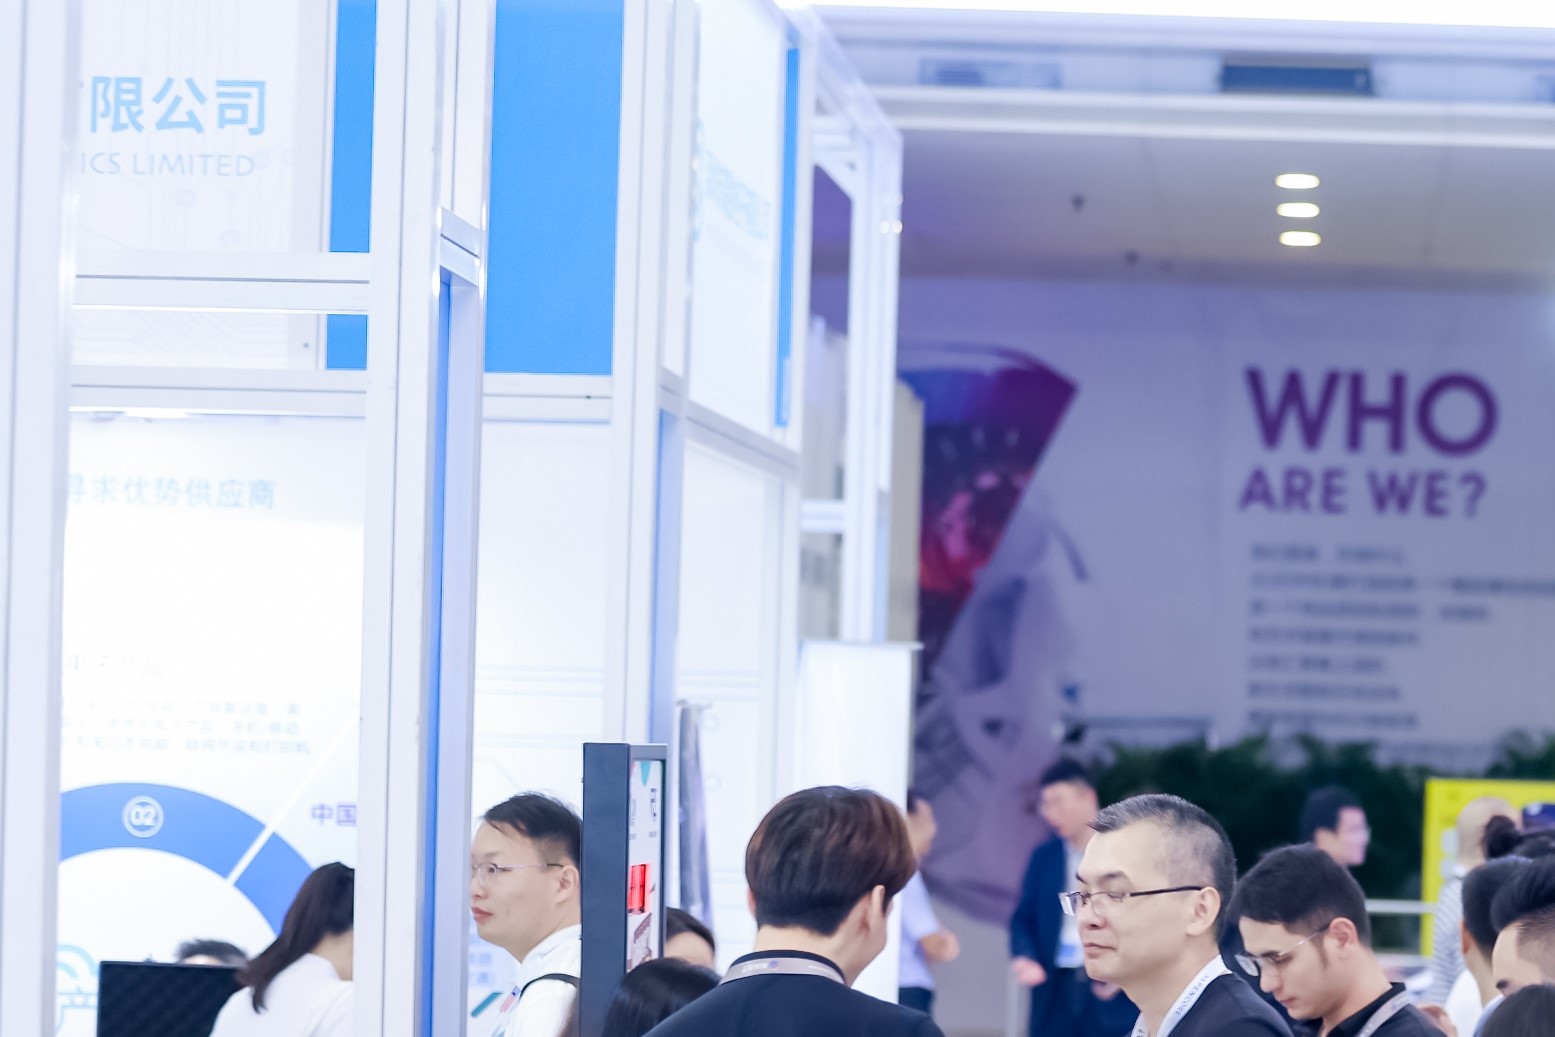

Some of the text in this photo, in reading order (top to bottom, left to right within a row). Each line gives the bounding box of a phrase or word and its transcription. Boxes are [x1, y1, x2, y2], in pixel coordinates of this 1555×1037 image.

[79, 76, 267, 136] 限公司
[133, 153, 256, 177] LIMITED
[1245, 366, 1499, 458] WHO
[1239, 467, 1487, 519] ARE WE?
[129, 804, 157, 827] 02
[311, 803, 357, 827] 中国
